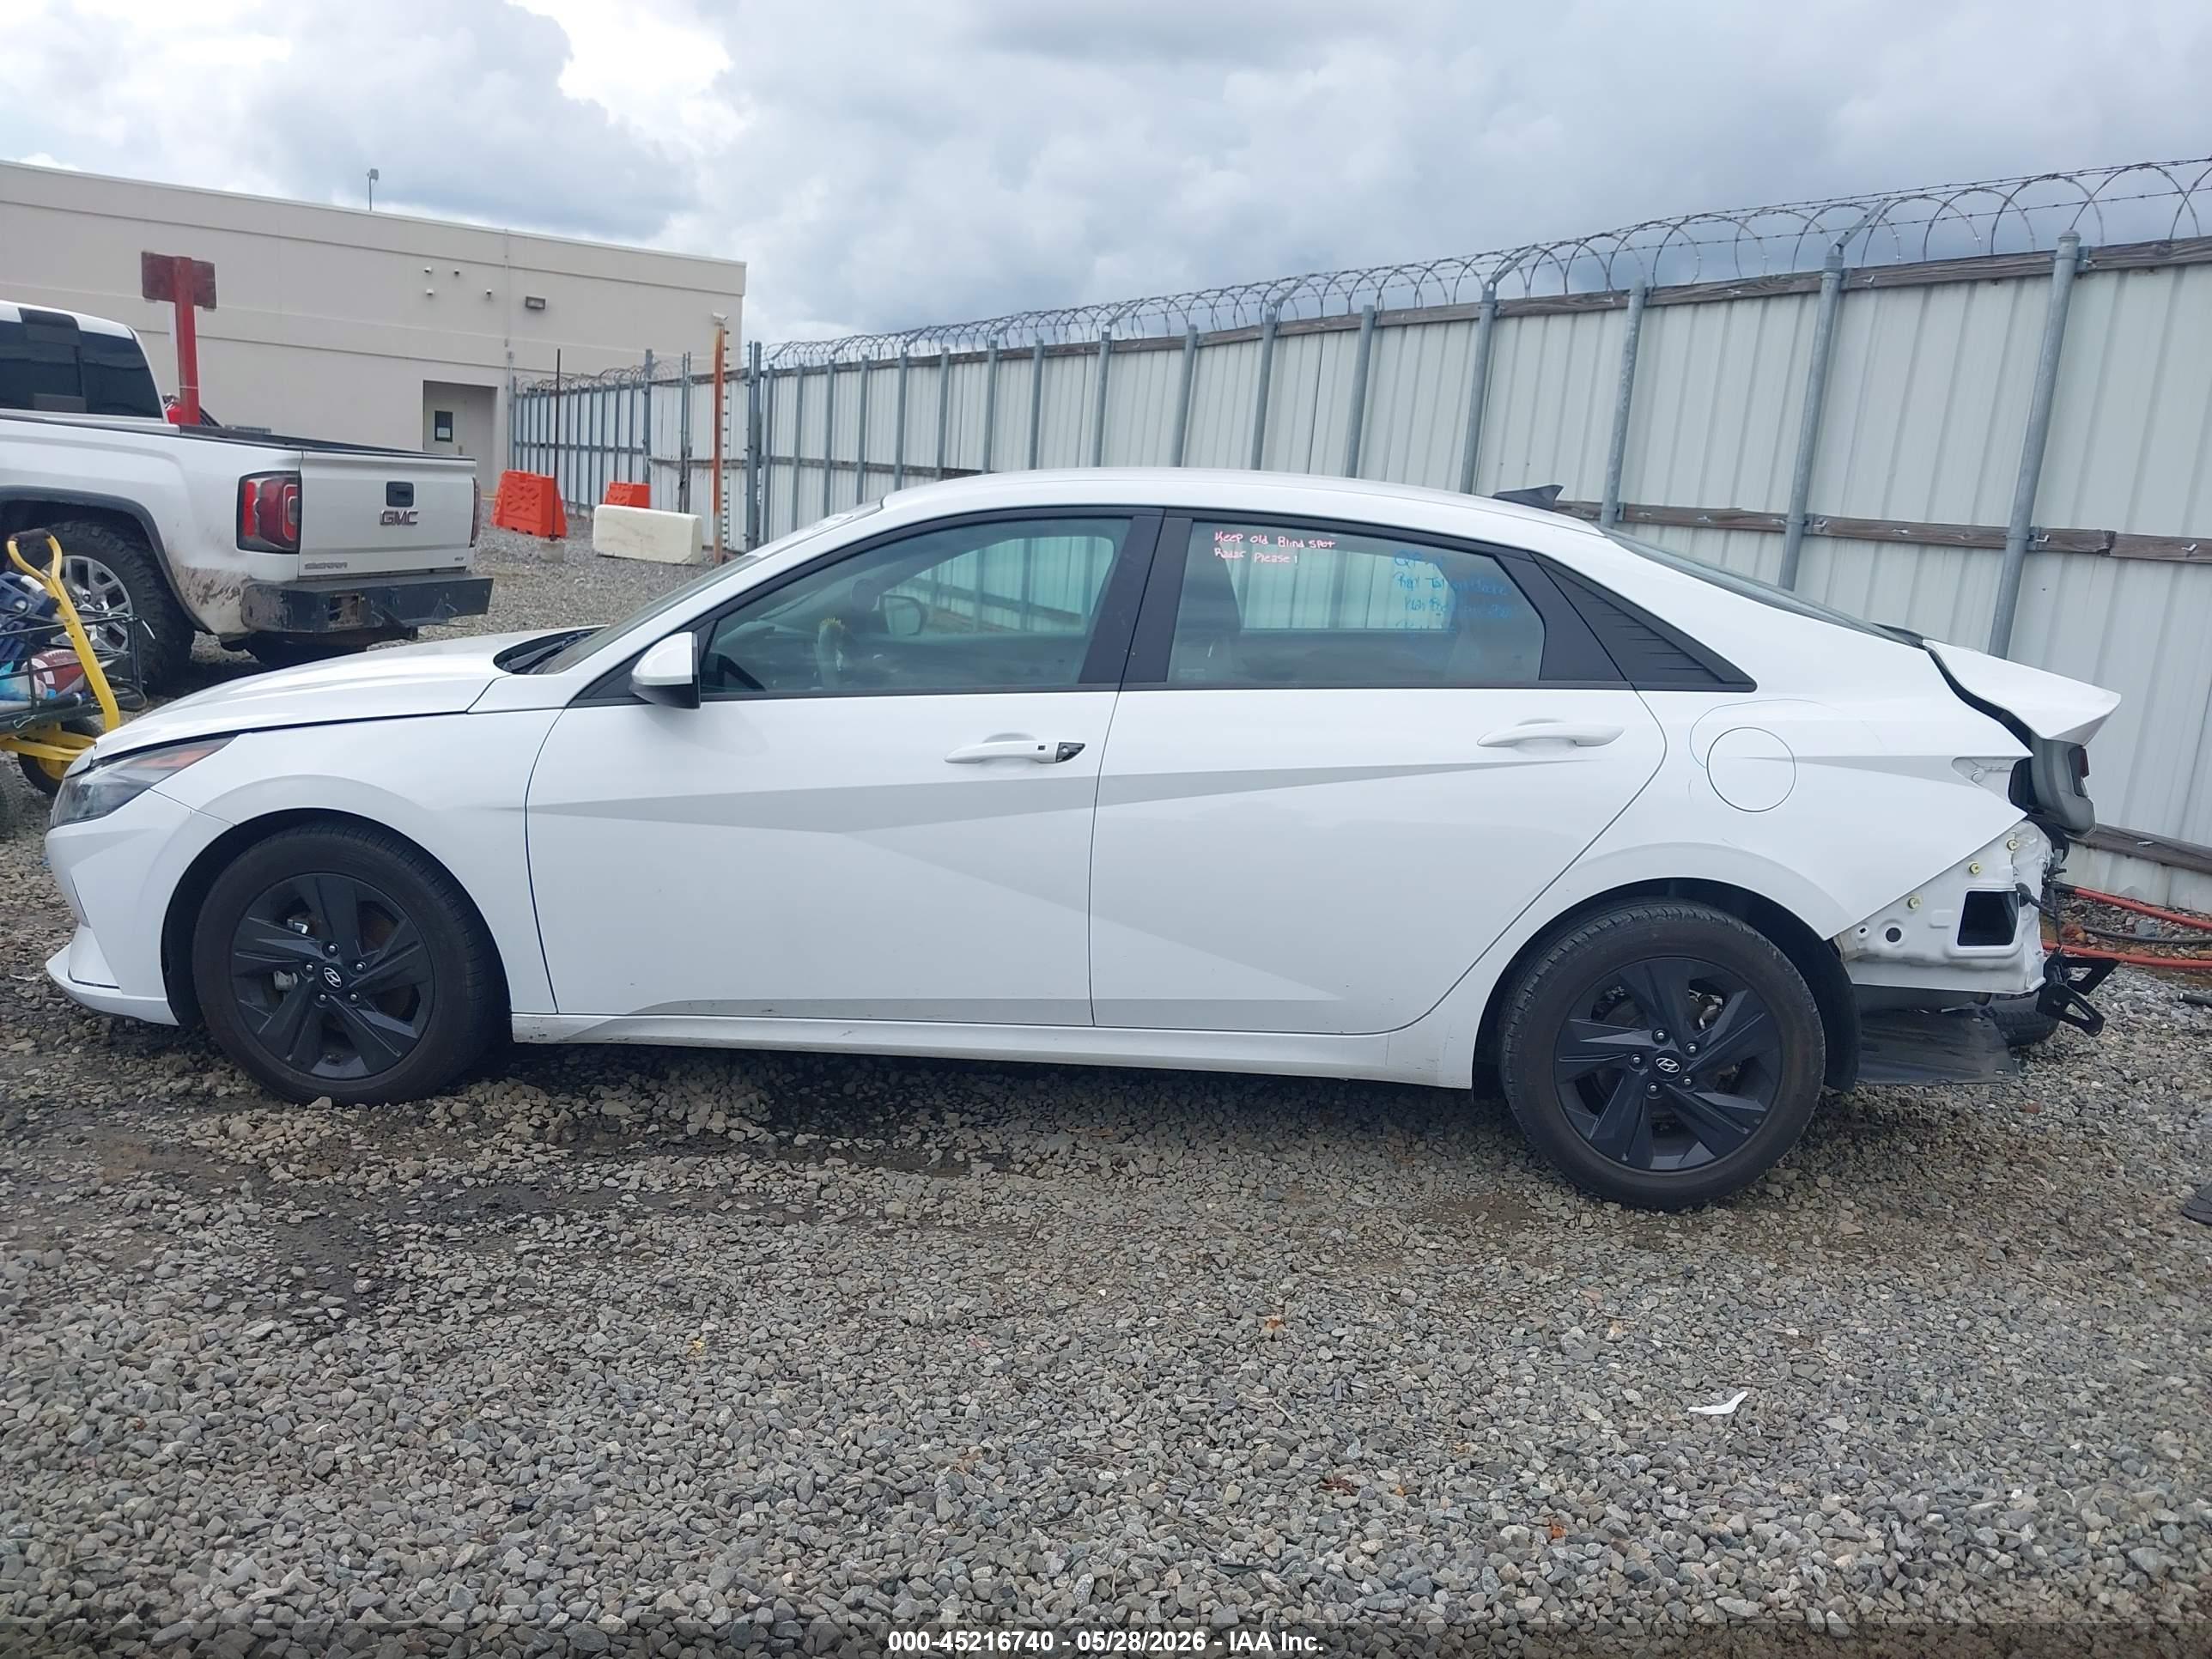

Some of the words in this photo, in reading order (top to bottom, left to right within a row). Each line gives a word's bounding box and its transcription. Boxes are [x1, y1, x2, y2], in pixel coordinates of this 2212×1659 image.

[380, 509, 419, 526] GMC
[1277, 536, 1305, 548] Blind
[1213, 547, 1247, 559] Radar
